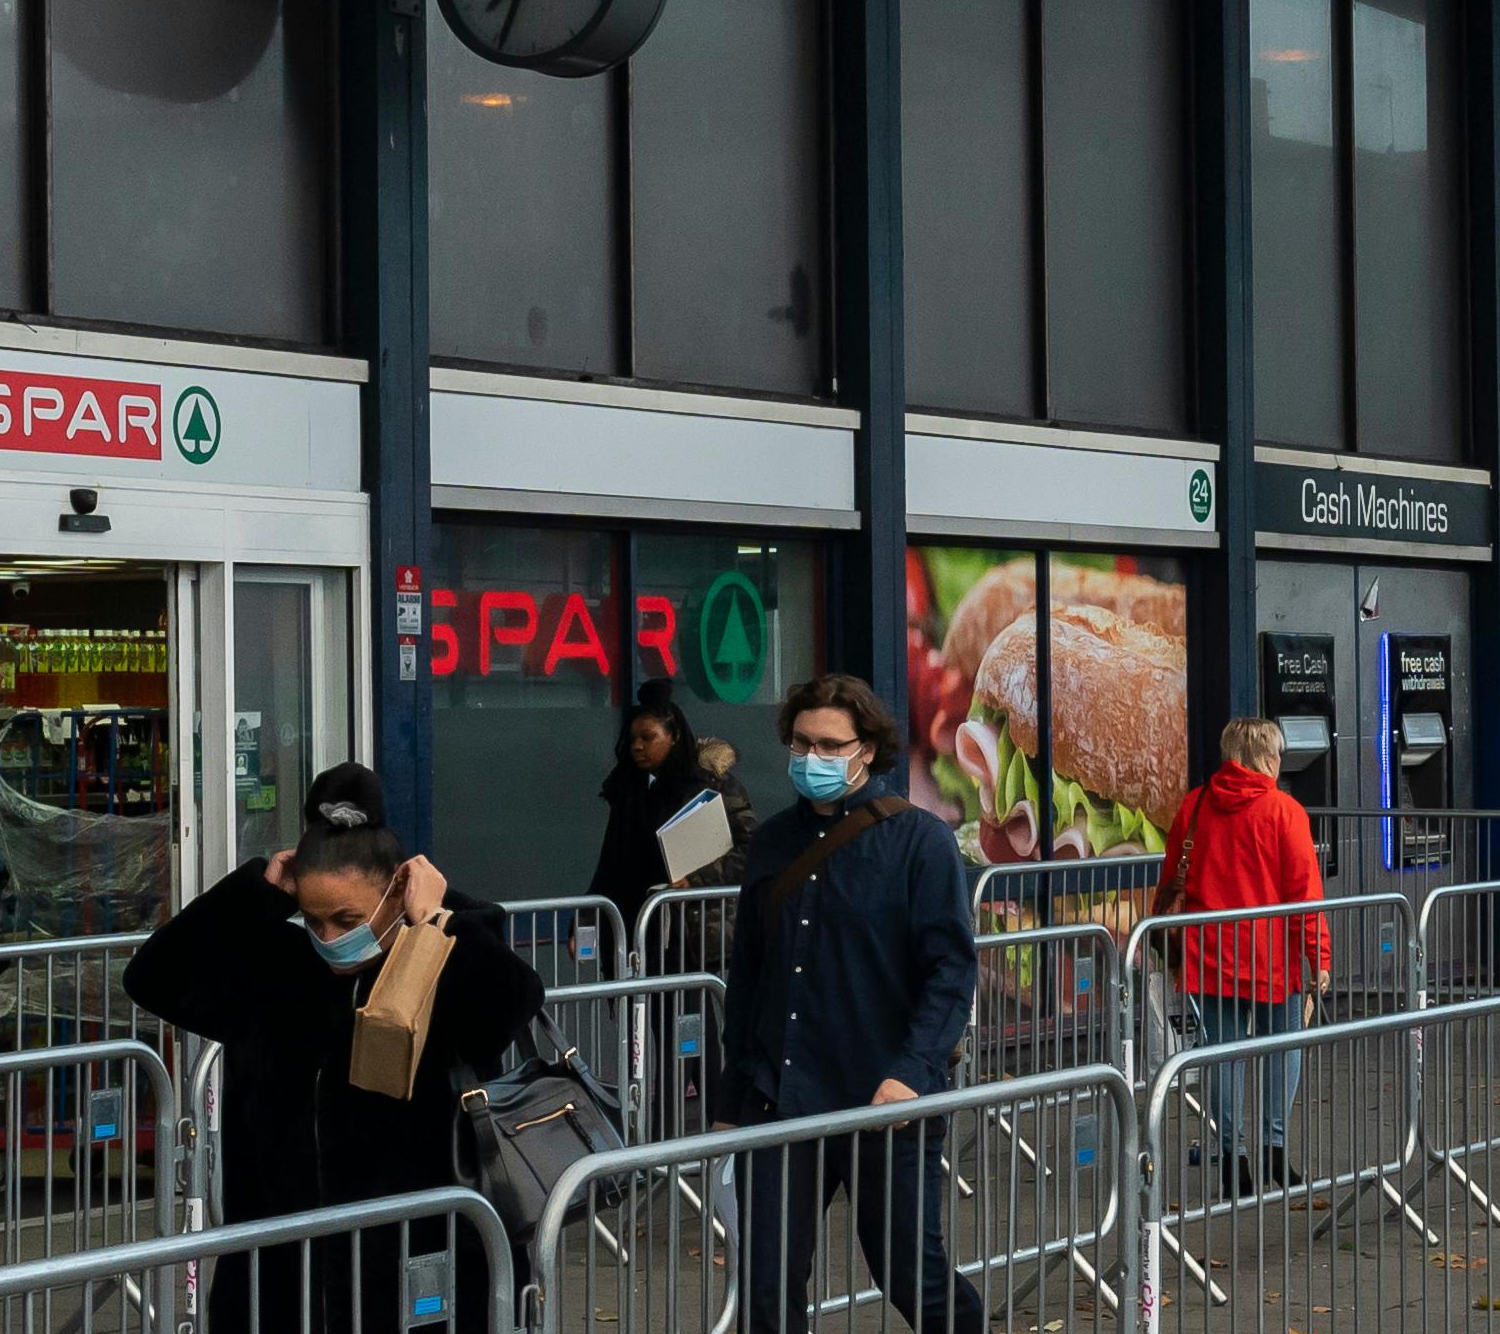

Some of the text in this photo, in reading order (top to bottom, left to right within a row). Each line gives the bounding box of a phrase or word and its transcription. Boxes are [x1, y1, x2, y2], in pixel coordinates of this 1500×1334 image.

[1192, 479, 1209, 502] 24
[1301, 478, 1448, 533] Cash Machines
[430, 589, 678, 677] SPAR
[1277, 653, 1328, 675] Free Cash
[1401, 651, 1445, 673] free cash
[1141, 1283, 1154, 1318] c2c
